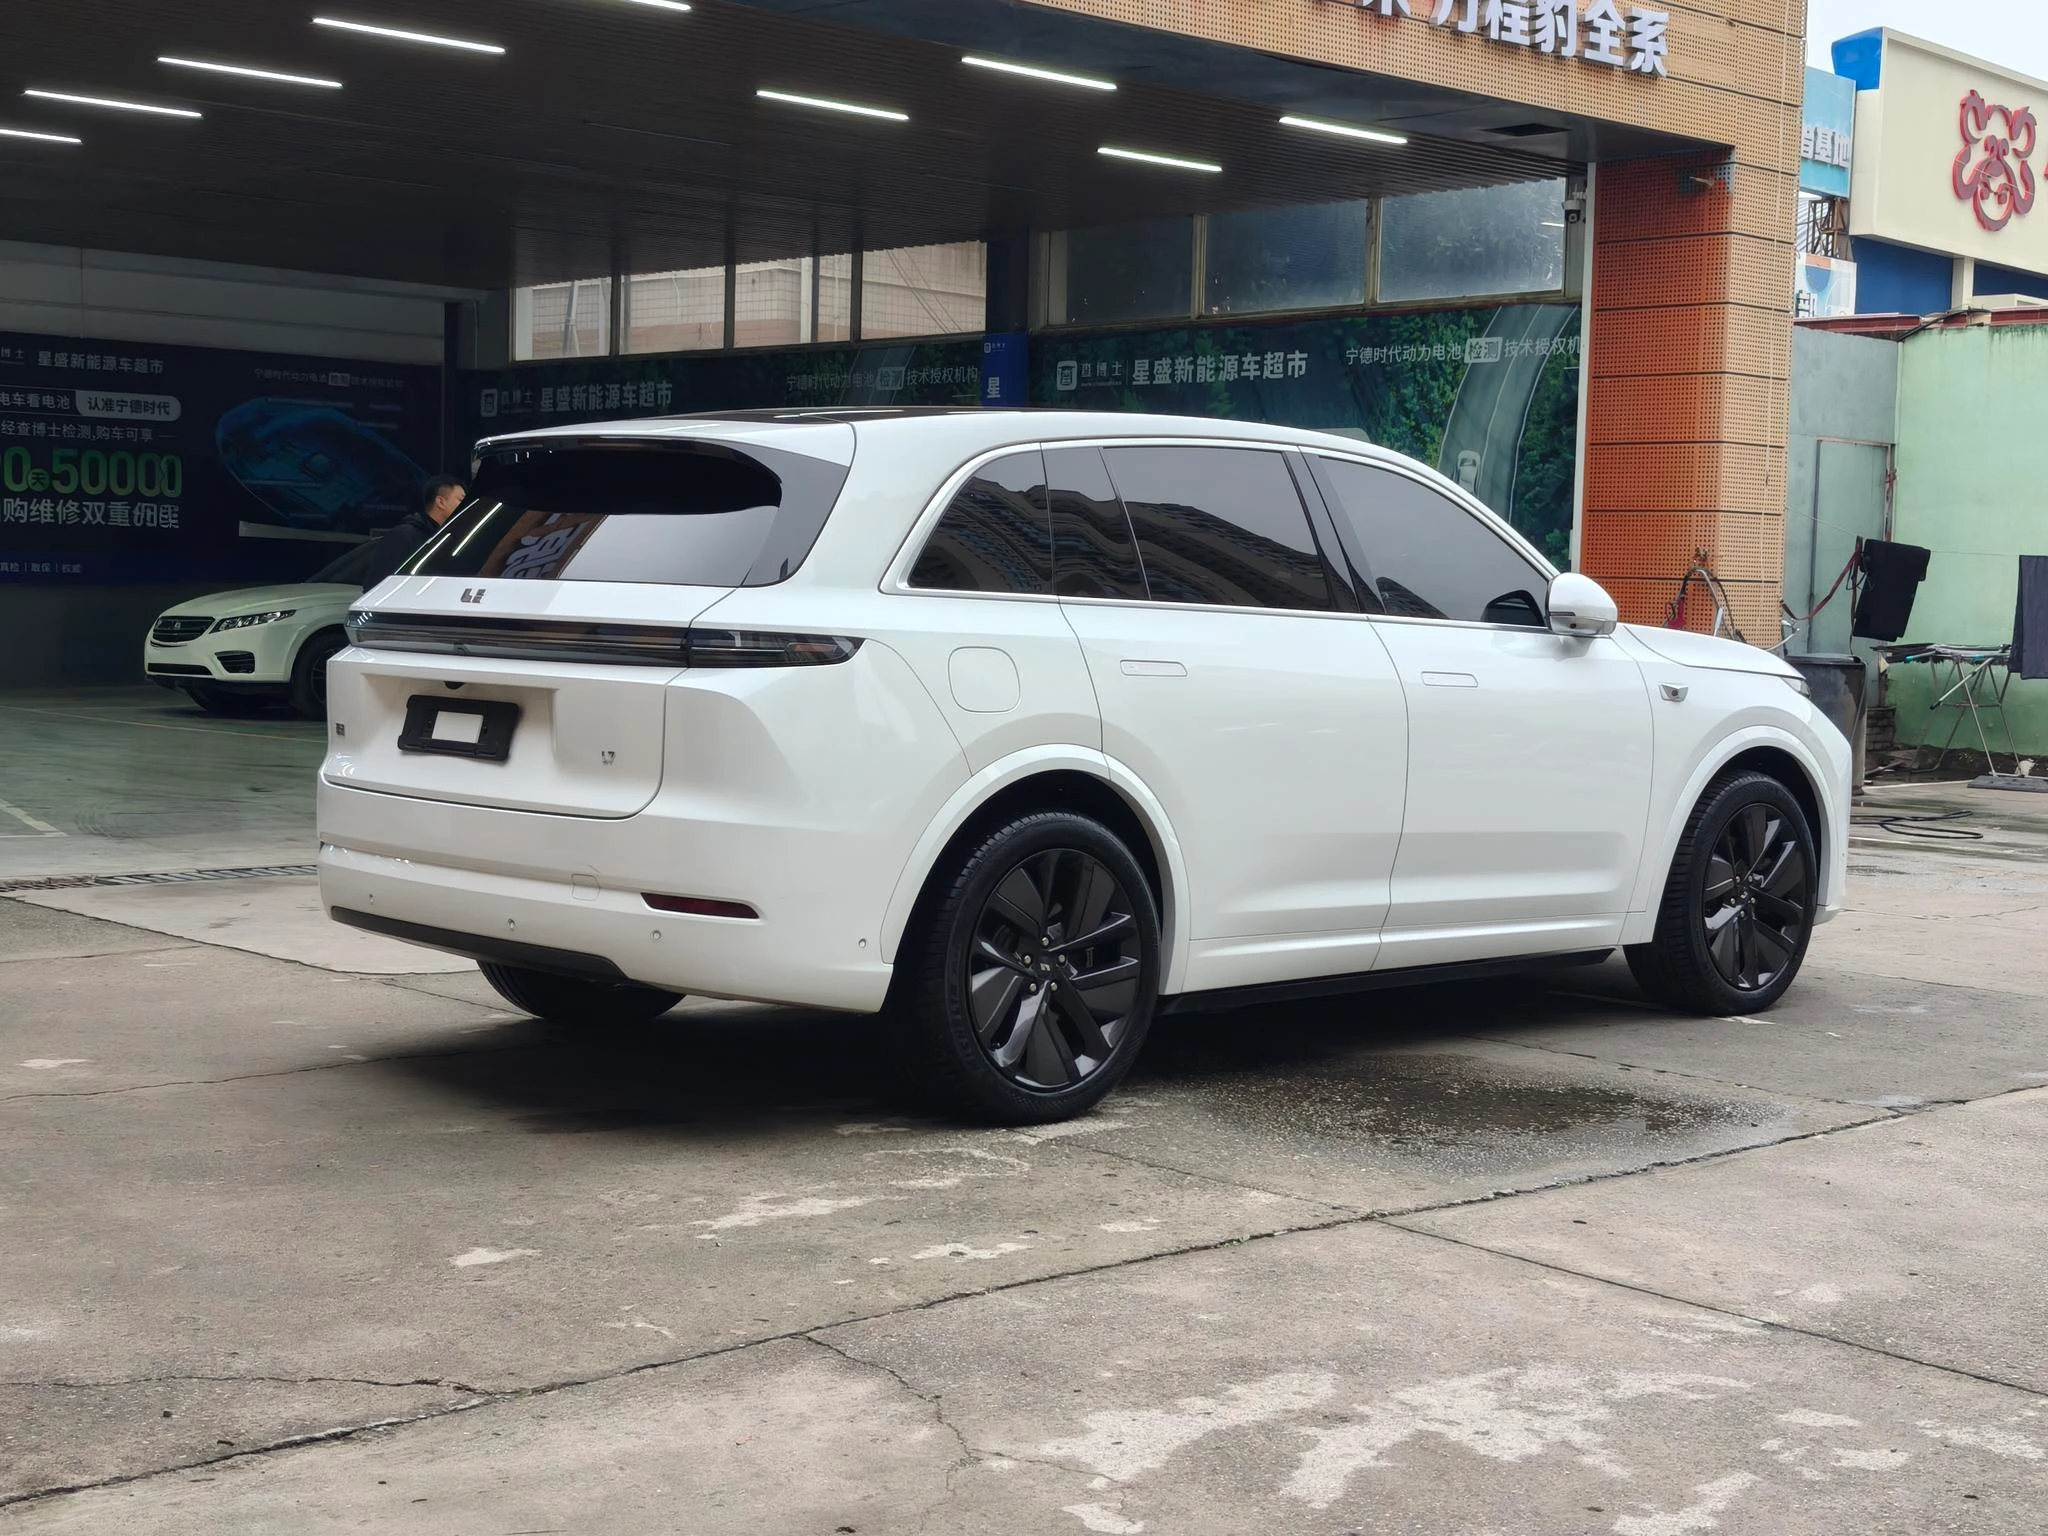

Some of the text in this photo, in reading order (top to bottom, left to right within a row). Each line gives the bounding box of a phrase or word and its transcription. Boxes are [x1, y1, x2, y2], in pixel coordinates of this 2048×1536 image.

[1361, 0, 1669, 77] 程豹全系
[37, 350, 164, 374] 星盛新能源车超市
[1132, 350, 1308, 385] 星盛新能源车超市
[0, 393, 171, 416] 电车看电池 认准宁德时代
[540, 381, 672, 412] 星盛新能源车超市
